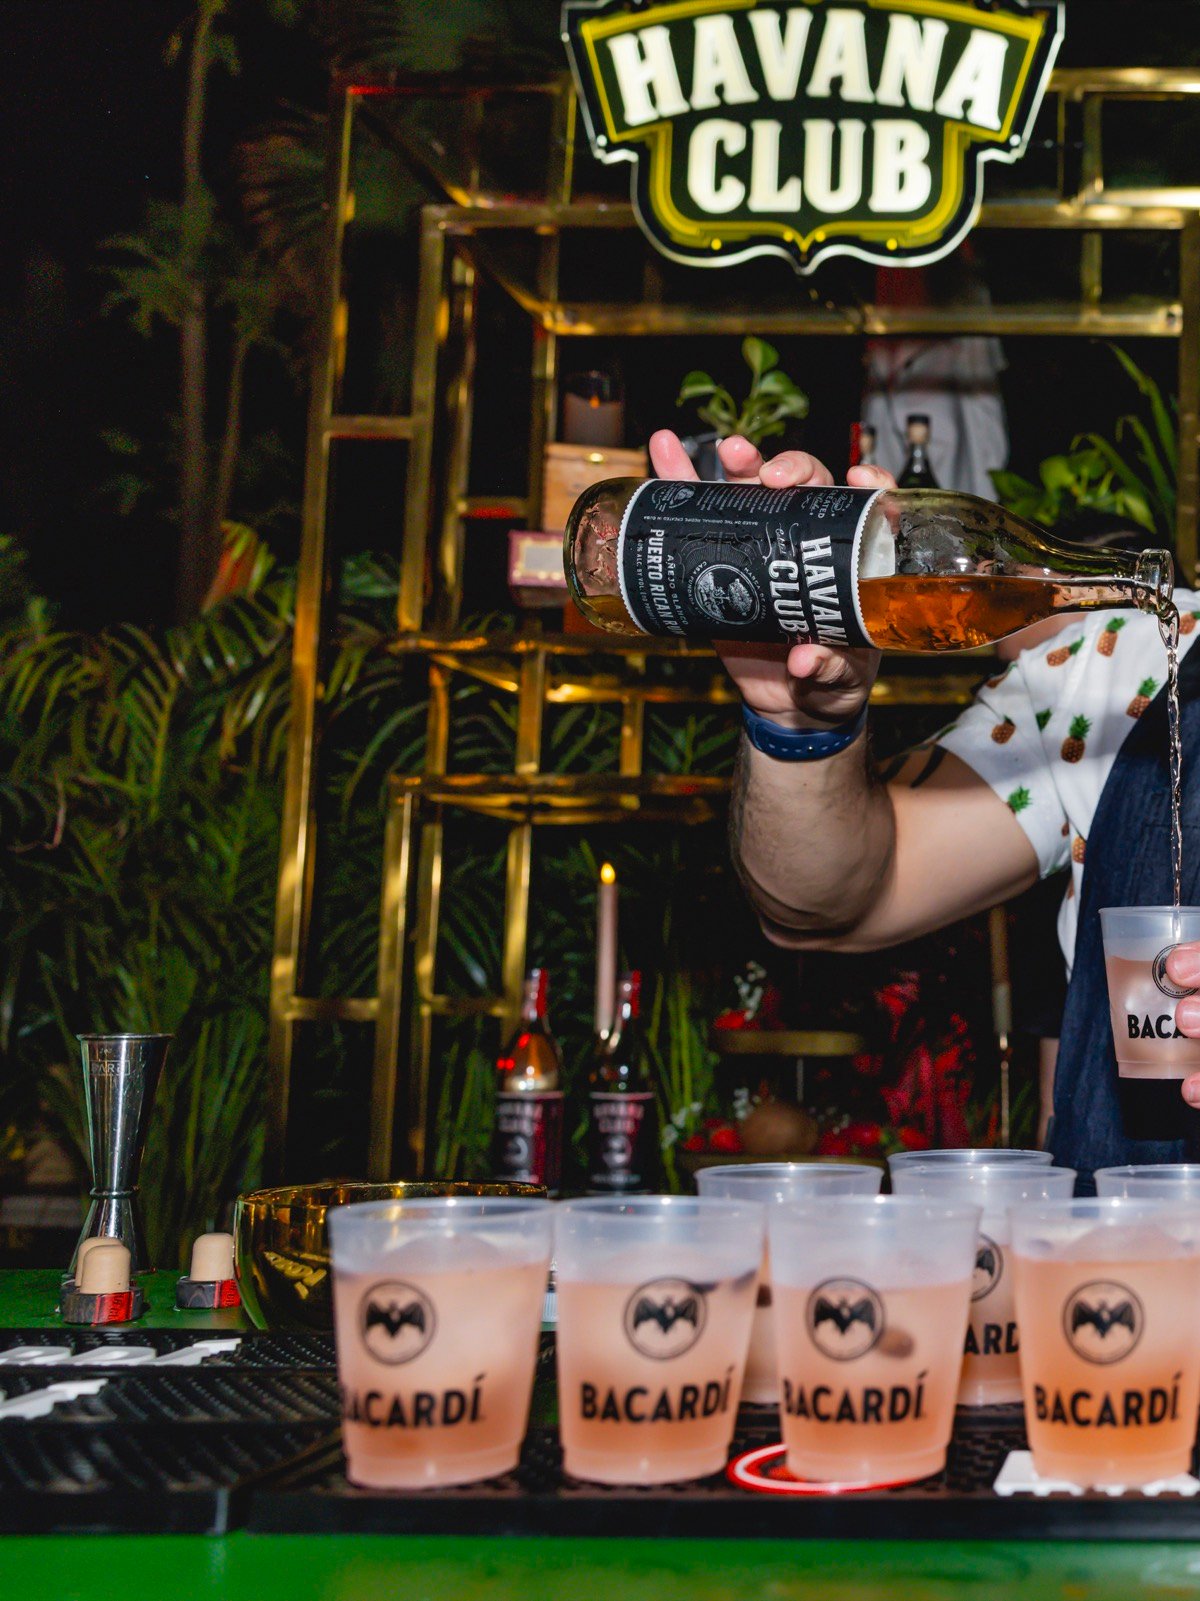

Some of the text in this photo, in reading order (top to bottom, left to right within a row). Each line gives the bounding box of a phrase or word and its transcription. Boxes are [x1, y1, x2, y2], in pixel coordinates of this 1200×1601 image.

[606, 8, 1009, 131] HAVANA
[687, 118, 932, 214] CLUB
[646, 528, 665, 581] PUERTO
[666, 554, 689, 625] AÑEJO BLANCO
[649, 583, 674, 618] RICAN
[768, 560, 810, 633] CLUB
[801, 536, 849, 647] HAVANA
[580, 1365, 735, 1422] BACARDÍ
[1033, 1370, 1182, 1427] BACARDÍ
